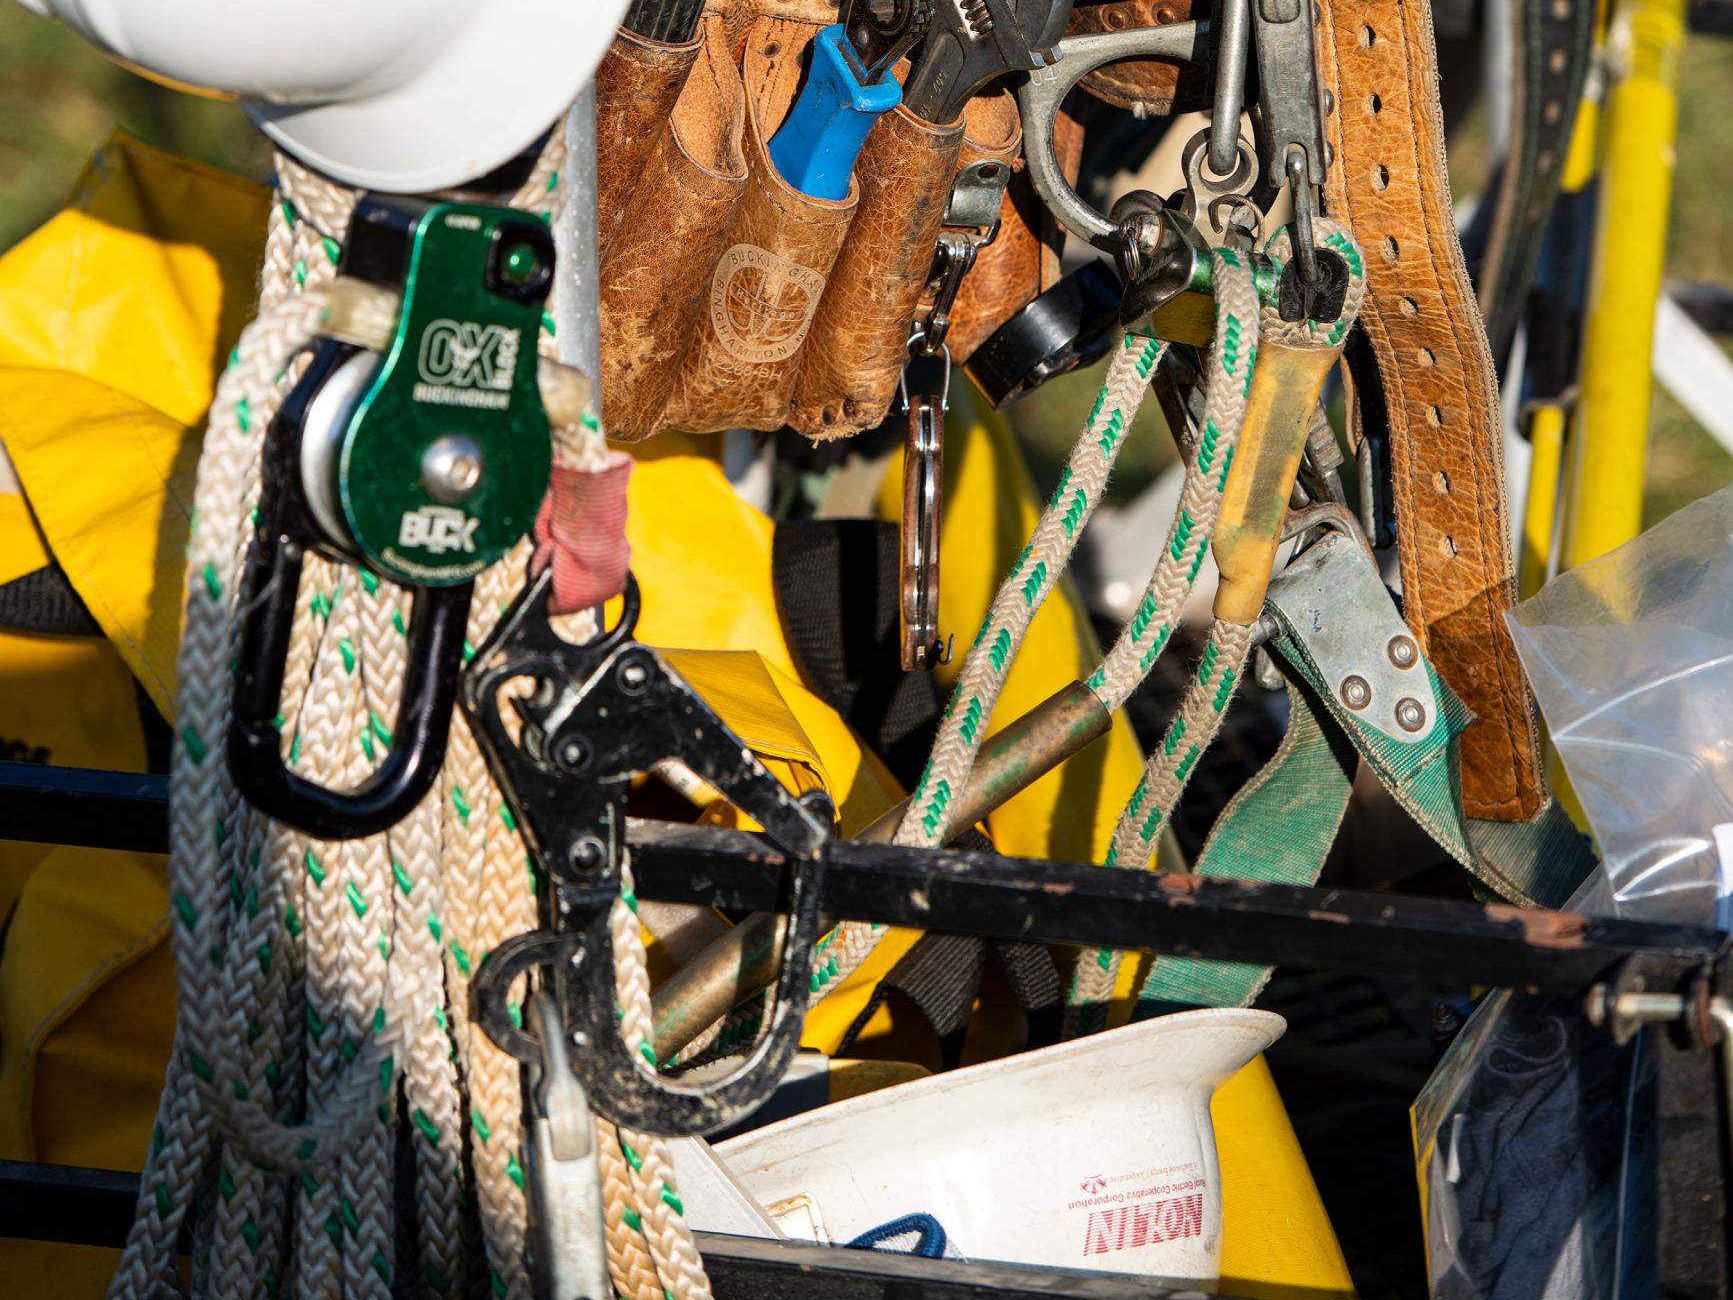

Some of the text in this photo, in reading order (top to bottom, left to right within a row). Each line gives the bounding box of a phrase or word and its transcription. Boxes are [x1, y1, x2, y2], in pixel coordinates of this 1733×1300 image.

[418, 318, 505, 388] OX
[398, 511, 480, 553] BUCK
[1126, 1183, 1171, 1200] Cooperative
[1173, 1181, 1194, 1193] Electric
[1068, 1193, 1124, 1211] Corporation
